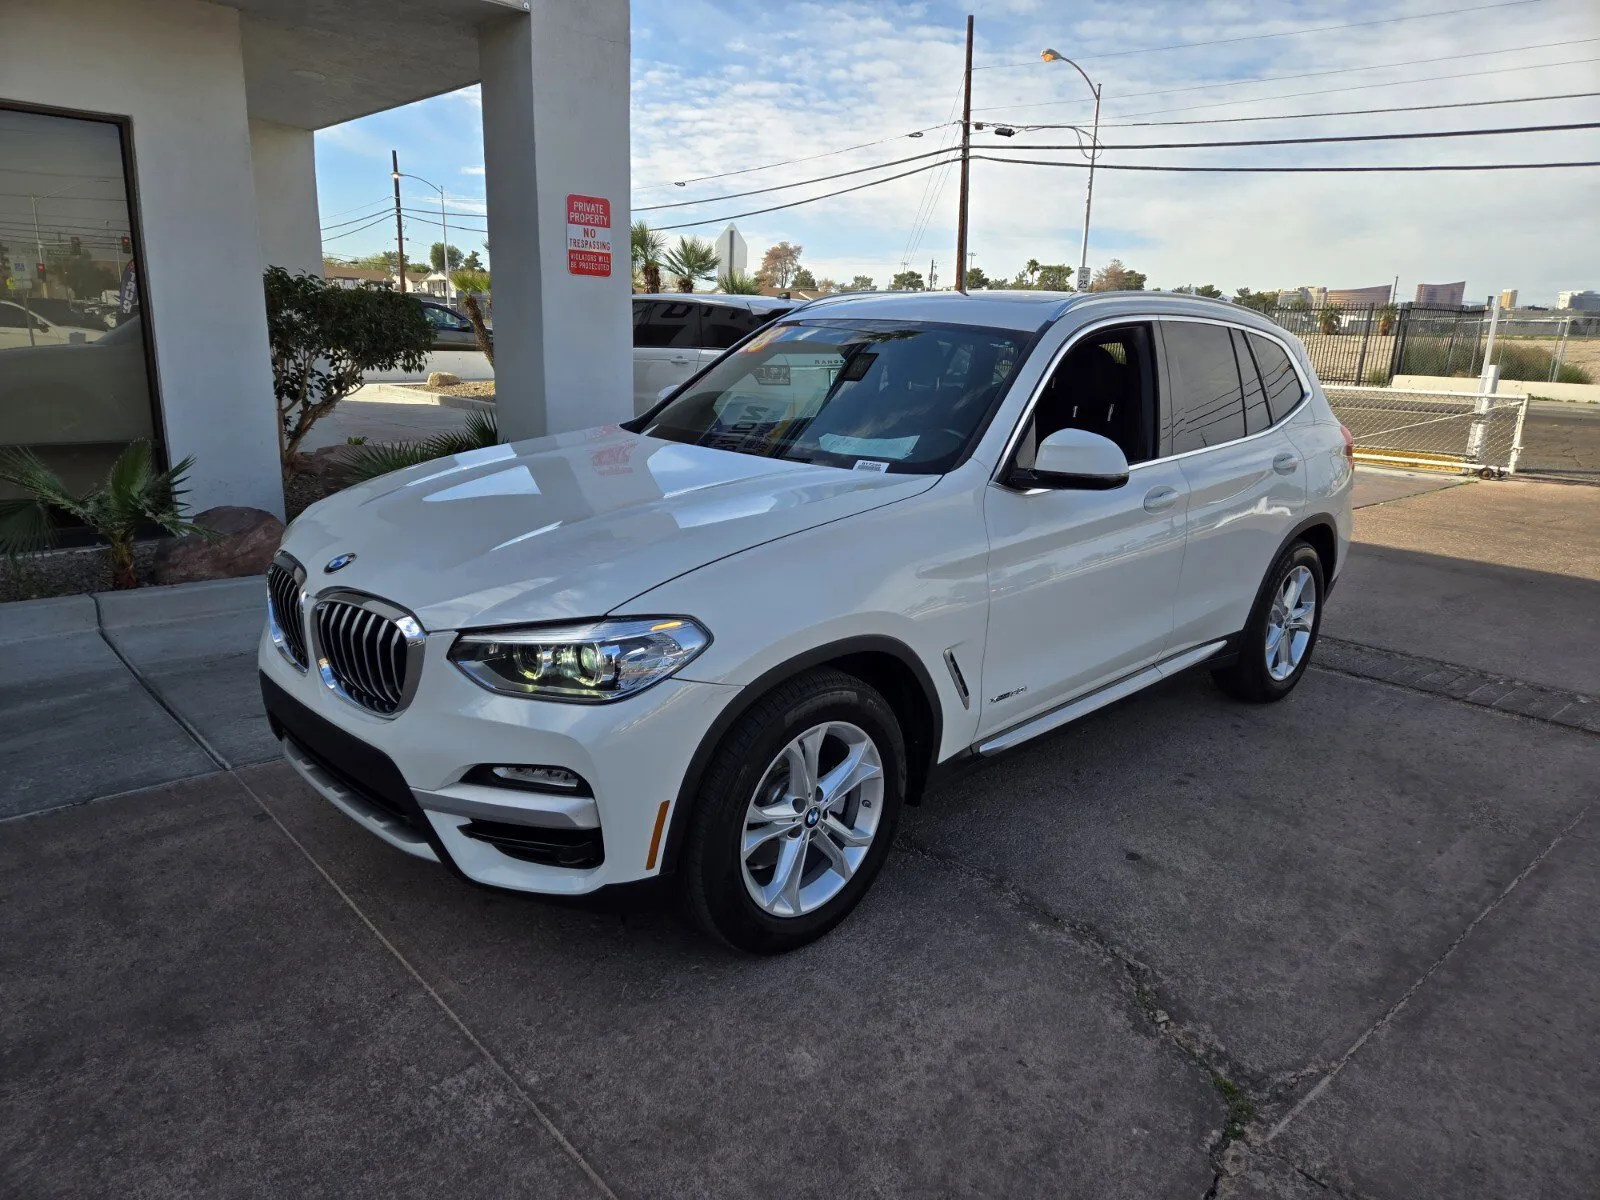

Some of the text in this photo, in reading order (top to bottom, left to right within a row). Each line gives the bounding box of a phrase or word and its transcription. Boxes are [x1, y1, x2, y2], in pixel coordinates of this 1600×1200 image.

[573, 201, 604, 215] PRIVATE
[569, 212, 608, 226] PROPERTY
[583, 227, 596, 239] NO
[569, 238, 611, 251] TRESPASSING
[570, 253, 610, 263] VIOLATORS WILL
[570, 261, 610, 271] BE PROSECUTED
[1078, 279, 1088, 289] 25
